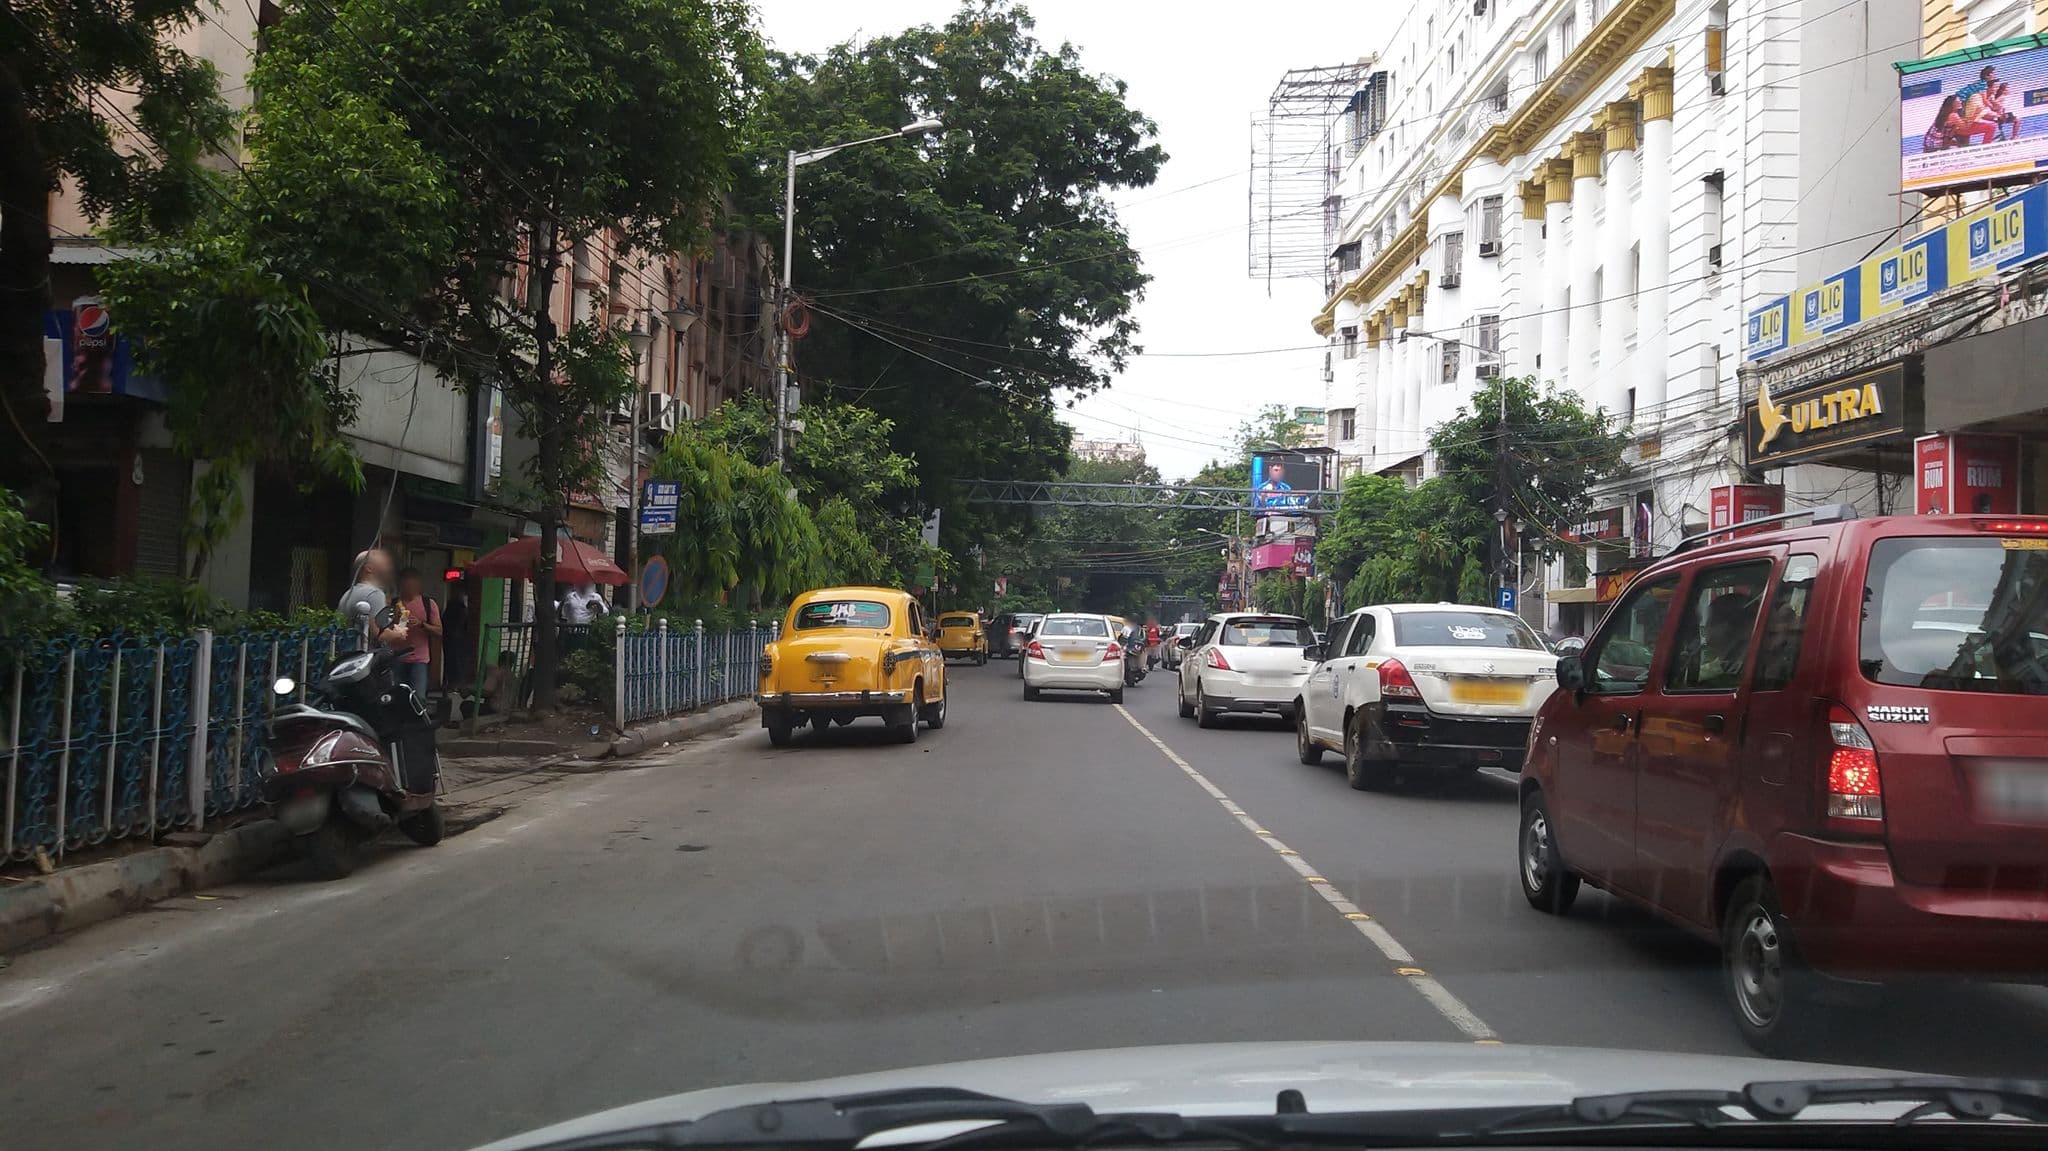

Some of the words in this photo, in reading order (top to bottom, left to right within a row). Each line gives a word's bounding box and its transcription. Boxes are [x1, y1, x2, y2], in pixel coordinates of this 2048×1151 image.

[1993, 209, 2019, 246] LIC
[1900, 251, 1923, 283] LIC
[1821, 285, 1841, 314] LIC
[1762, 310, 1780, 337] LIC
[1791, 383, 1882, 433] ULTRA
[1924, 467, 1943, 489] RUM
[1967, 466, 2001, 488] RUM
[1502, 591, 1511, 606] P
[1448, 625, 1486, 633] Uber
[1867, 705, 1929, 713] MARUTI
[1868, 713, 1930, 721] SUZUKI
